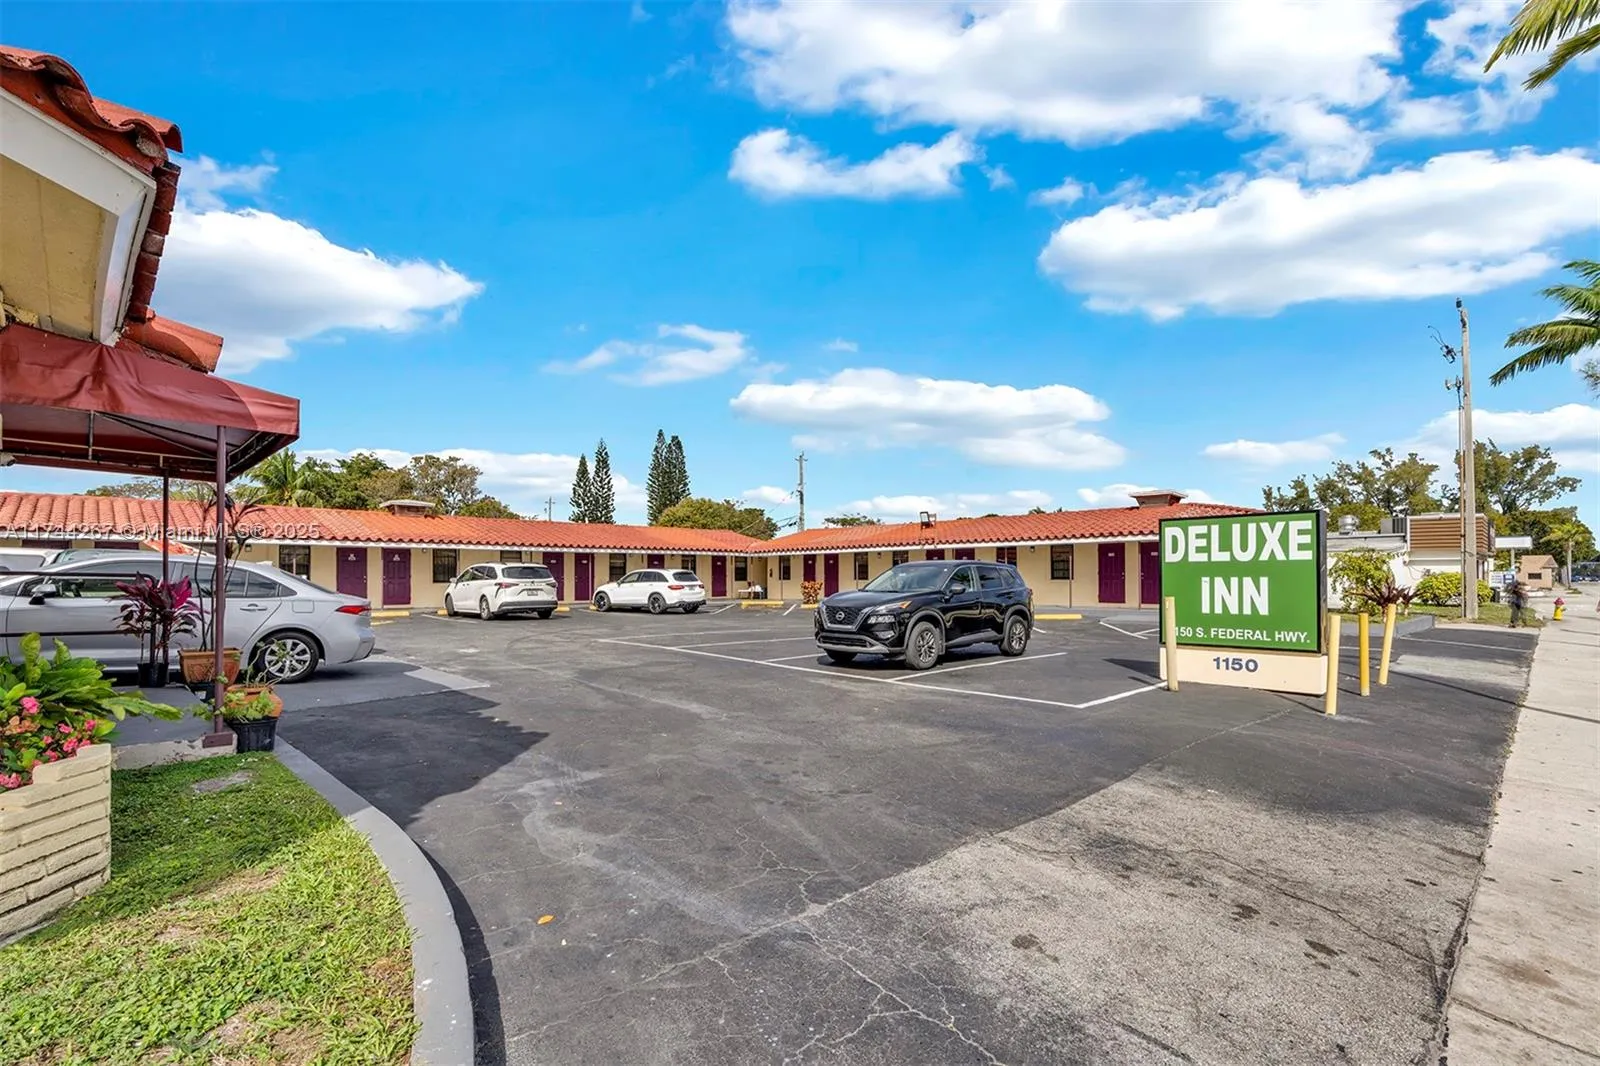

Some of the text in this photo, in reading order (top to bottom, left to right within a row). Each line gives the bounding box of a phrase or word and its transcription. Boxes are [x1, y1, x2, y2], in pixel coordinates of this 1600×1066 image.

[1164, 520, 1313, 562] DELUXE
[1201, 577, 1269, 615] INN
[1196, 627, 1207, 638] S.
[1211, 628, 1271, 641] FEDERAL
[1275, 631, 1310, 643] HWY.
[1213, 656, 1259, 673] 1150
